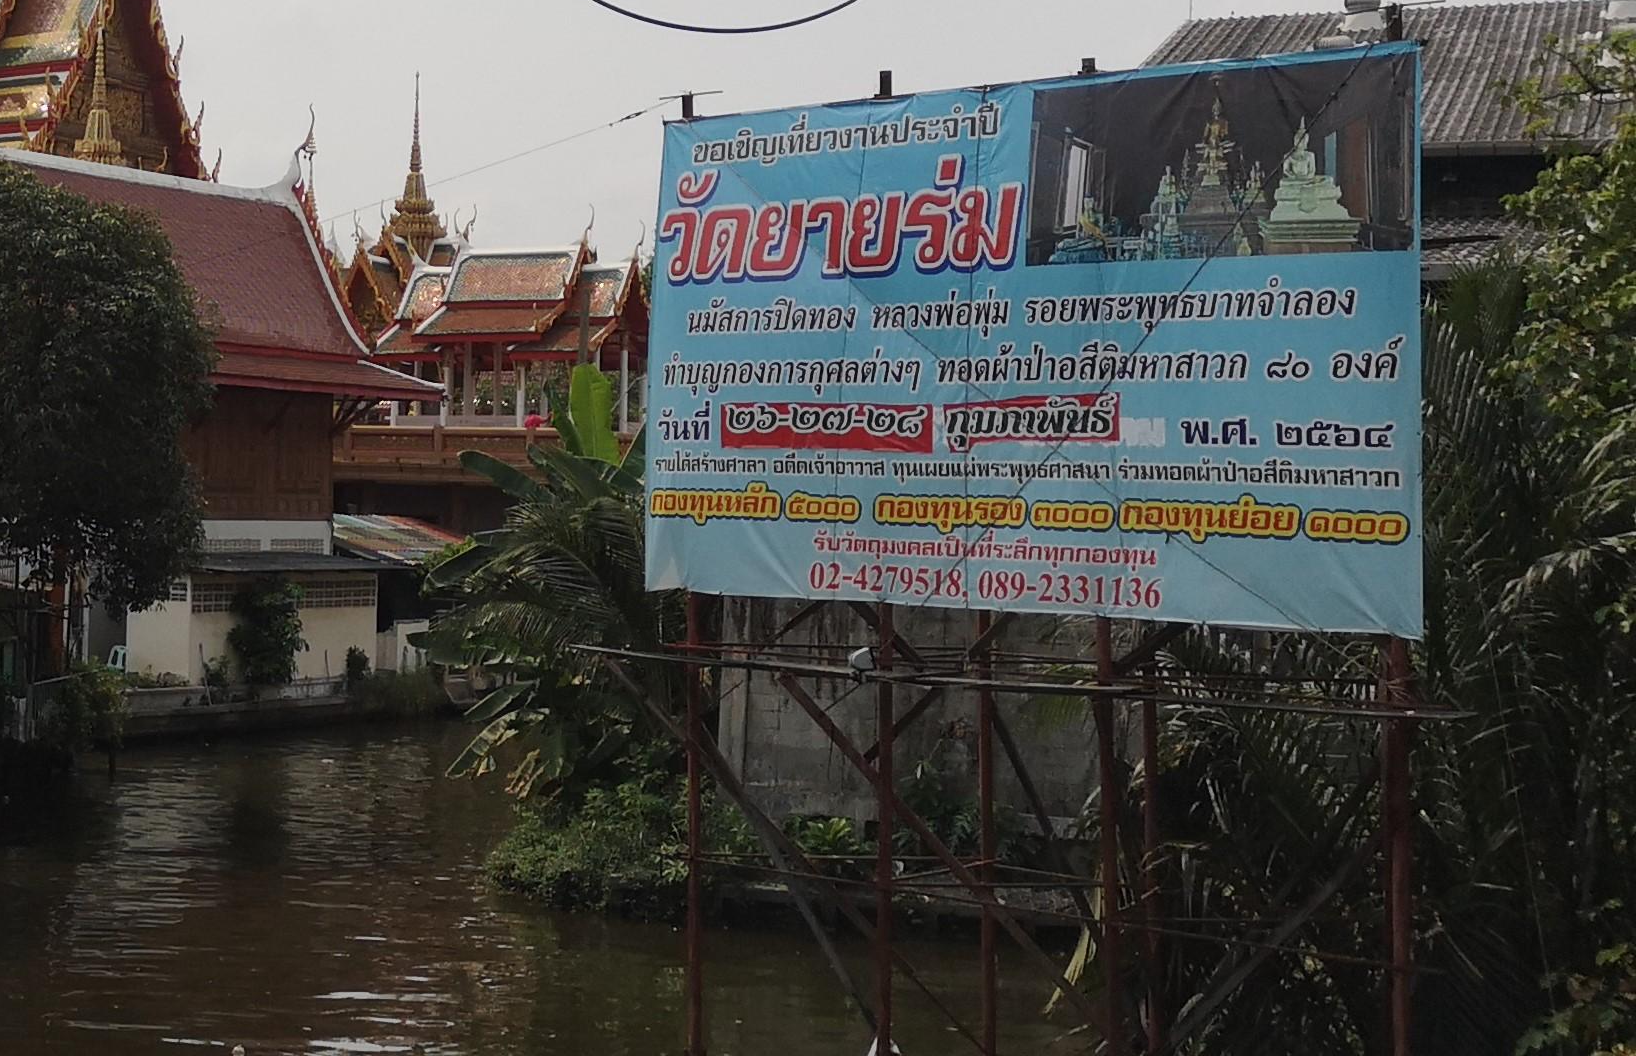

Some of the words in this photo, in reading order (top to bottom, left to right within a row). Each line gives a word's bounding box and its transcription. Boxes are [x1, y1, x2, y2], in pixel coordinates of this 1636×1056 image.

[694, 103, 1000, 164] ขอเชิญเที่ยวงานประจำปี
[661, 155, 1023, 284] วัดยายร่ม
[687, 297, 857, 334] นมัสการปิดทอง
[873, 289, 1008, 338] หลวงพ่อพุ่ม
[1024, 276, 1357, 333] รอยพระพุทธบาทจำลอง
[663, 348, 921, 395] ทำบุญกองการกุศลต่างๆ
[938, 340, 1247, 384] ทอดผ้าป่าอสีติมหาสาวก
[1266, 351, 1310, 379] ๘๐
[1332, 335, 1404, 380] องค์
[657, 401, 711, 441] วันที่
[725, 403, 929, 437] ๒๖-๒๗-๒๘
[947, 393, 1116, 450] กุมภาพันธ์
[1180, 417, 1259, 445] พ.ศ.
[1275, 420, 1394, 448] ๒๕๖๔
[892, 456, 1110, 483] ทุนเผยแผ่พระพุทธศาสนา
[650, 483, 779, 523] กองทุนหลัก
[875, 497, 1025, 530] กองทุนรอง
[1120, 495, 1298, 538] กองทุนย่อย
[810, 561, 969, 601] 02-4279518,
[978, 569, 1163, 610] 089-2331136
